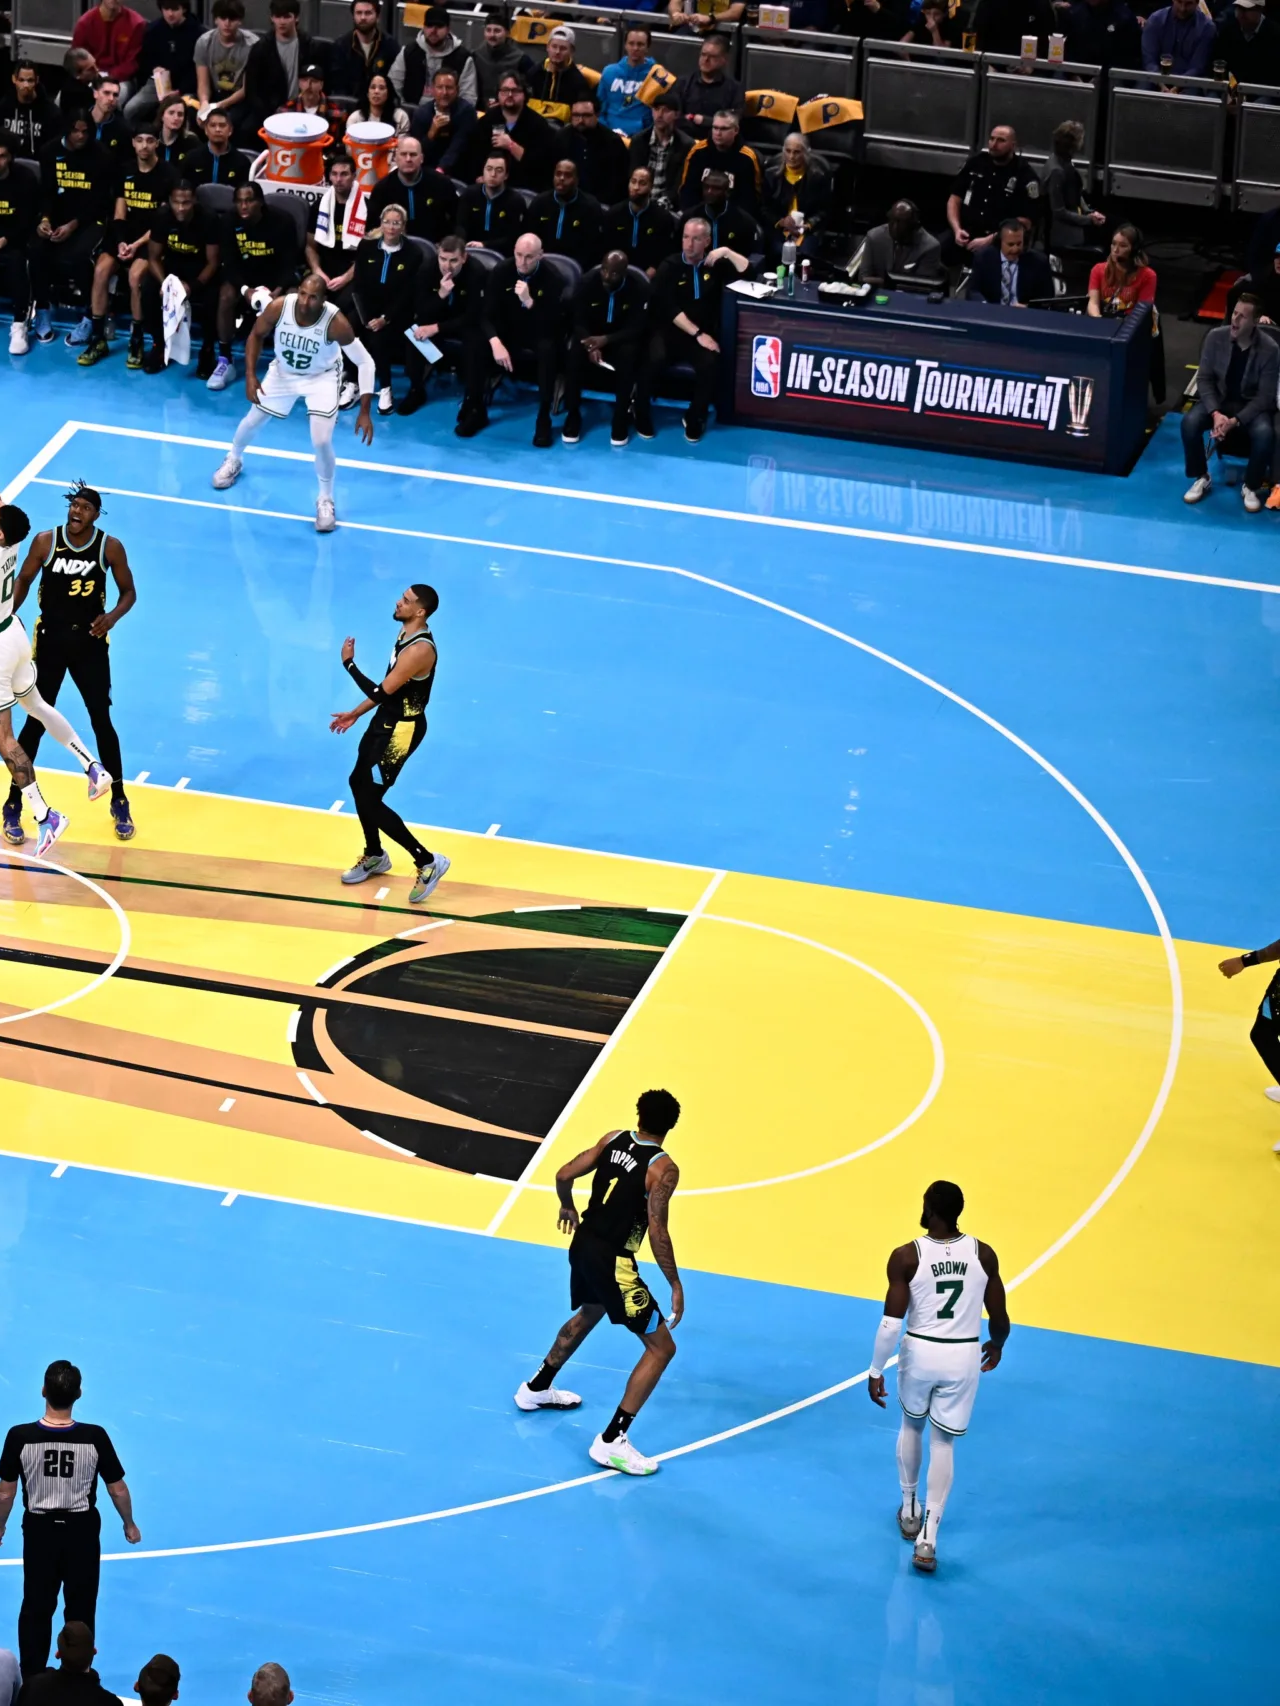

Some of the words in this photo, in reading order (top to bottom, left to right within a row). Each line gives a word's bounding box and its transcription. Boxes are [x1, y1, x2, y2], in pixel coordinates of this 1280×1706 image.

[56, 162, 68, 170] NBA
[277, 150, 292, 166] G
[357, 152, 373, 170] G
[279, 331, 320, 355] CELTICS
[281, 349, 313, 370] 42
[786, 352, 910, 404] IN-SEASON
[913, 359, 1070, 431] TOURNAMENT
[52, 557, 97, 577] INDY
[1, 569, 15, 604] 0
[68, 579, 96, 597] 33
[609, 1149, 638, 1173] TOPPIN
[601, 1177, 619, 1205] 1
[931, 1260, 968, 1278] BROWN
[935, 1280, 964, 1319] 7
[43, 1449, 75, 1479] 26
